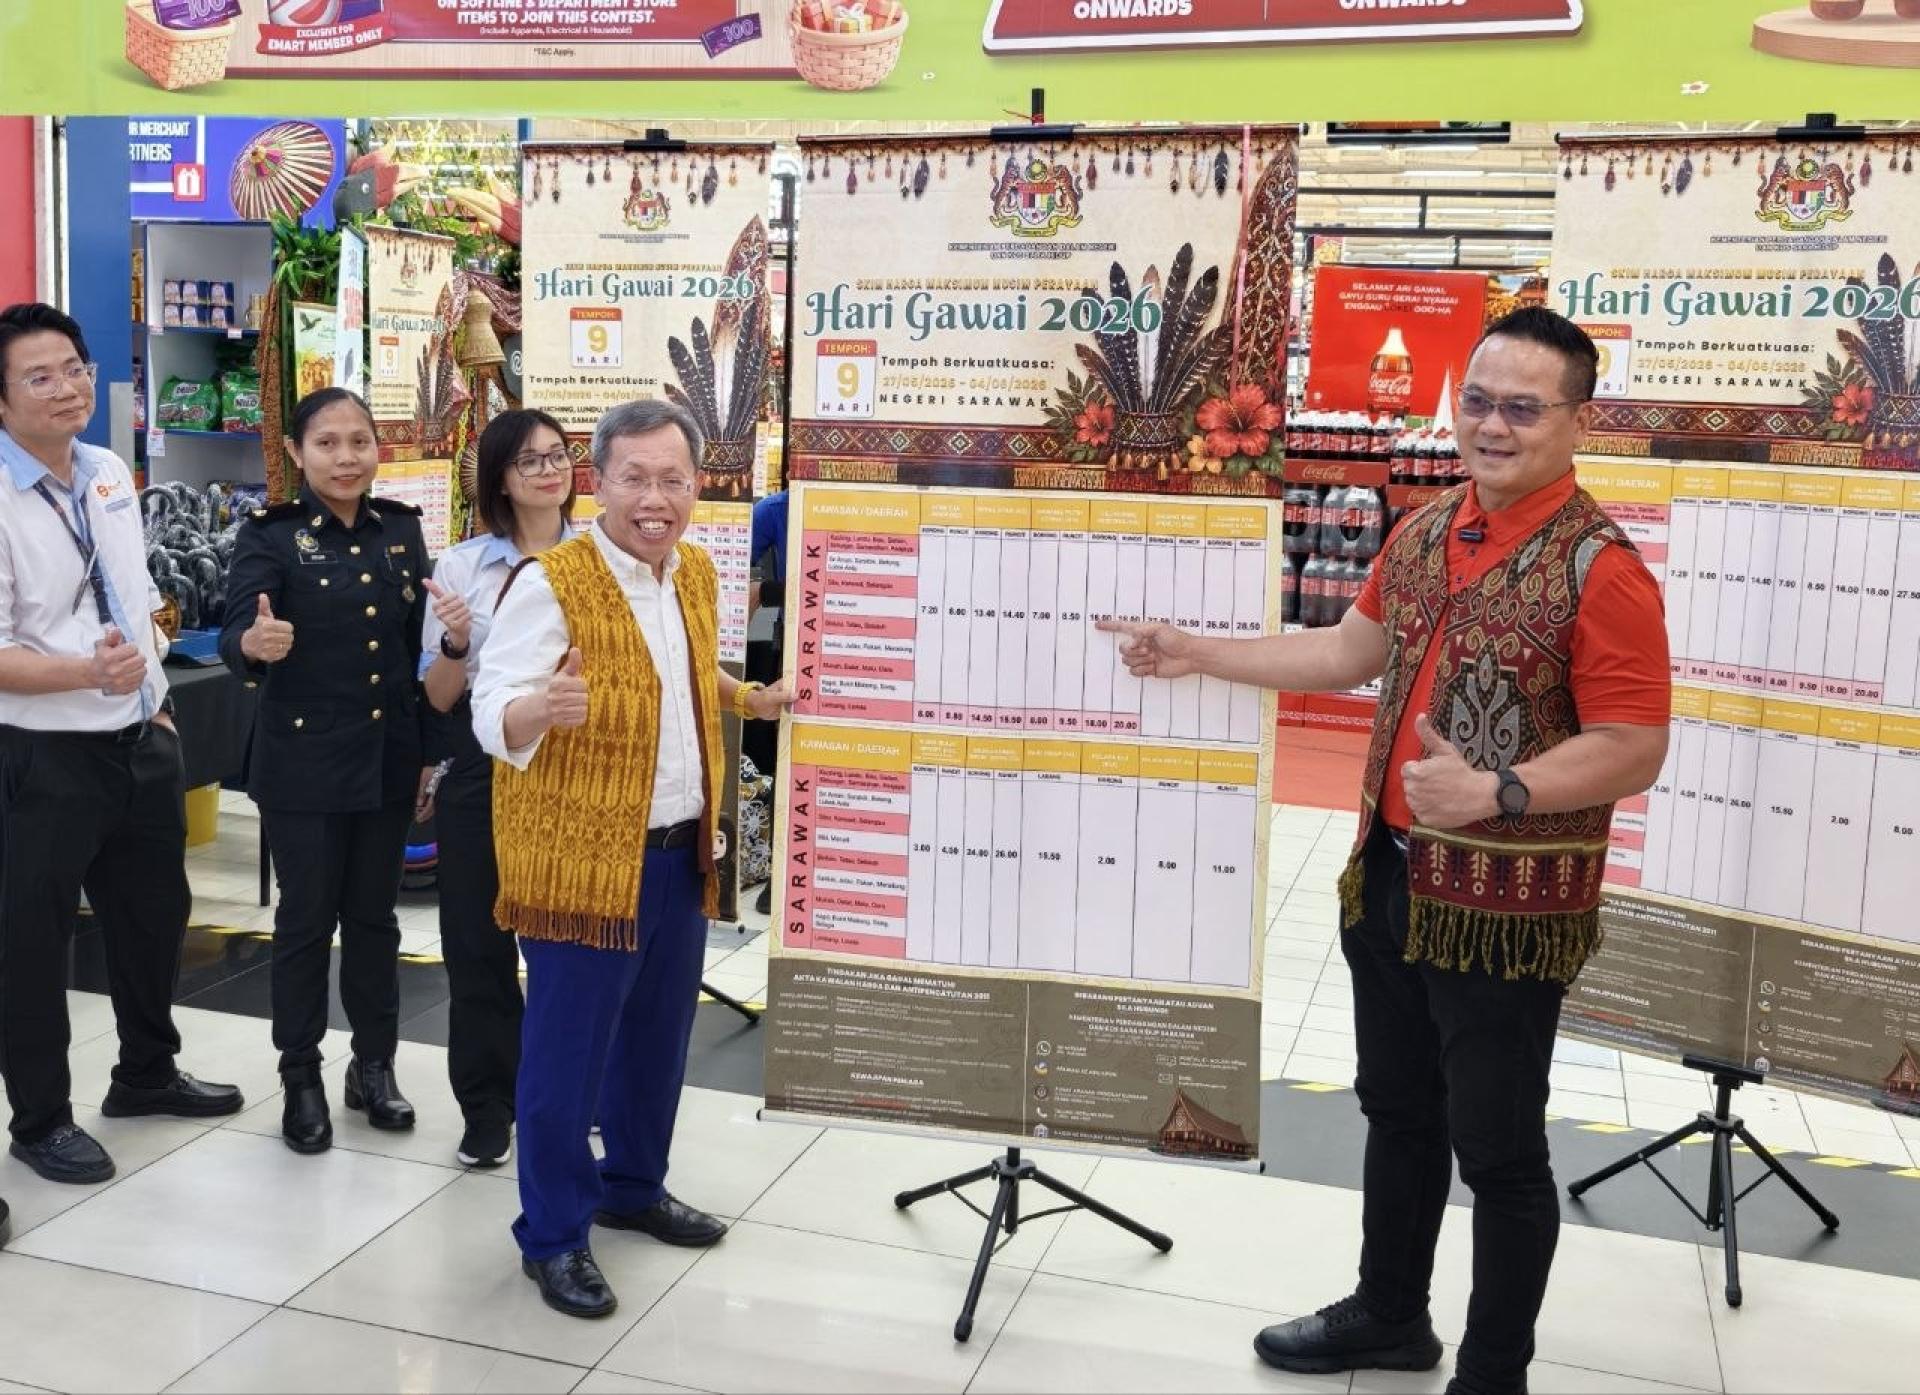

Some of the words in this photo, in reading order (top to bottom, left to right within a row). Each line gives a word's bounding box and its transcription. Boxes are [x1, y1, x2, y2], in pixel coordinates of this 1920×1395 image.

[1074, 0, 1193, 19] ONWARDS
[457, 11, 497, 24] ITEMS
[500, 11, 516, 23] TO
[520, 11, 554, 24] JOIN
[557, 11, 587, 23] THIS
[591, 11, 655, 23] CONTEST.
[296, 26, 337, 38] EXCLUSIVE
[338, 24, 354, 34] FOR
[723, 20, 755, 42] 100
[268, 38, 305, 51] EMART
[308, 36, 353, 51] MEMBER
[356, 28, 383, 45] ONLY
[139, 122, 190, 136] MERCHANT
[534, 267, 593, 300] Hari
[602, 272, 673, 303] Gawai
[680, 272, 754, 298] 2026
[1352, 283, 1394, 291] SELAMAT
[1559, 272, 1650, 318] Hari
[1663, 281, 1792, 326] Gawai
[1802, 276, 1920, 319] 2026
[803, 284, 893, 337] Hari
[905, 292, 1027, 341] Gawai
[1039, 284, 1163, 334] 2026
[588, 325, 608, 353] 9
[1636, 339, 1695, 352] Tempoh
[1701, 341, 1815, 353] Berkuatkuasa:
[824, 343, 871, 354] TEMPOH:
[577, 356, 619, 364] HARI
[881, 356, 938, 369] Tempoh
[944, 358, 1055, 370] Berkuatkuasa:
[530, 376, 576, 385] Tempoh
[837, 363, 860, 398] 9
[1634, 375, 1701, 385] NEGERI
[1714, 377, 1808, 388] SARAWAK
[822, 403, 871, 412] HARI
[880, 394, 945, 405] NEGERI
[958, 396, 1049, 408] SARAWAK
[812, 504, 859, 516] KAWASAN
[866, 507, 908, 518] DAERAH
[921, 606, 938, 615] 7.20
[801, 545, 821, 700] SARAWAK
[800, 739, 850, 752] KAWASAN
[858, 743, 900, 755] DAERAH
[790, 779, 810, 934] SARAWAK
[1098, 856, 1116, 865] 2.00
